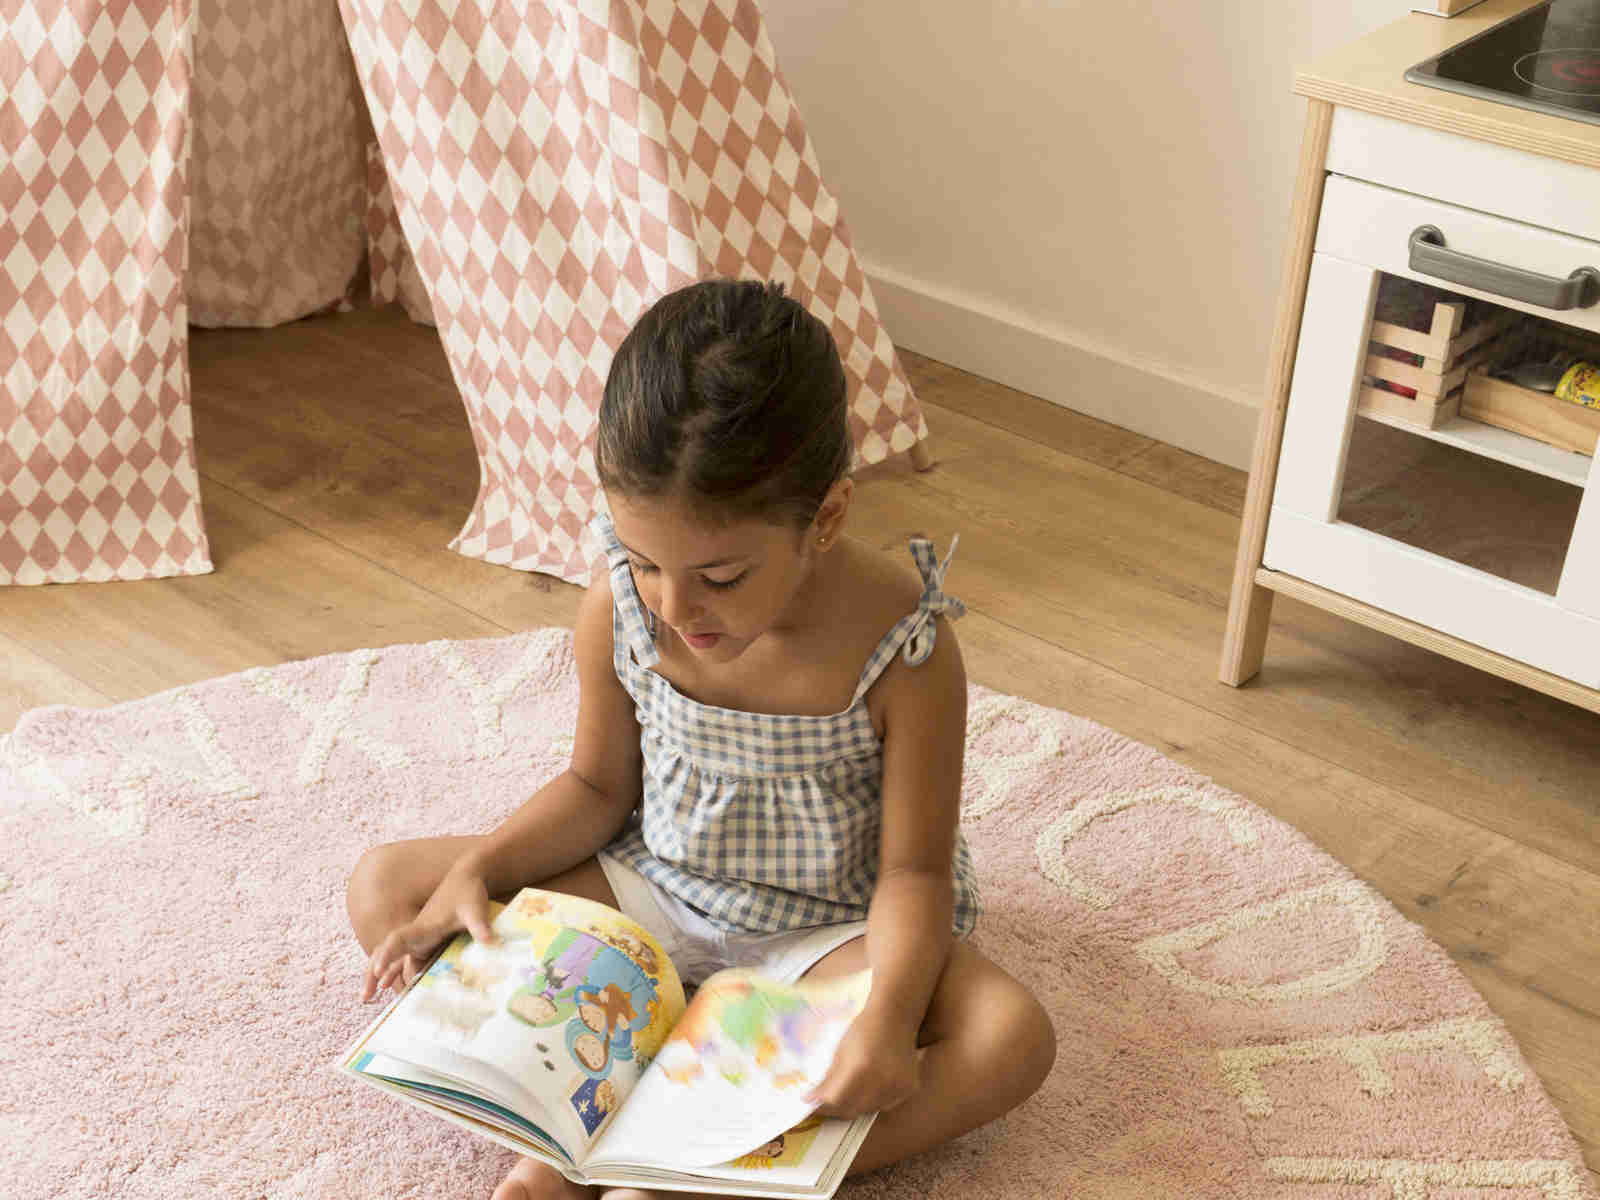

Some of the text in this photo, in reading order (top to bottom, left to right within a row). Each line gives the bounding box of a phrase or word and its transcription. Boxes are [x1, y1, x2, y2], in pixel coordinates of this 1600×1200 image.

[240, 664, 412, 786] X
[430, 628, 566, 760] Y
[1036, 786, 1260, 912] C
[1133, 882, 1387, 1003] D
[1217, 1015, 1527, 1118] E
